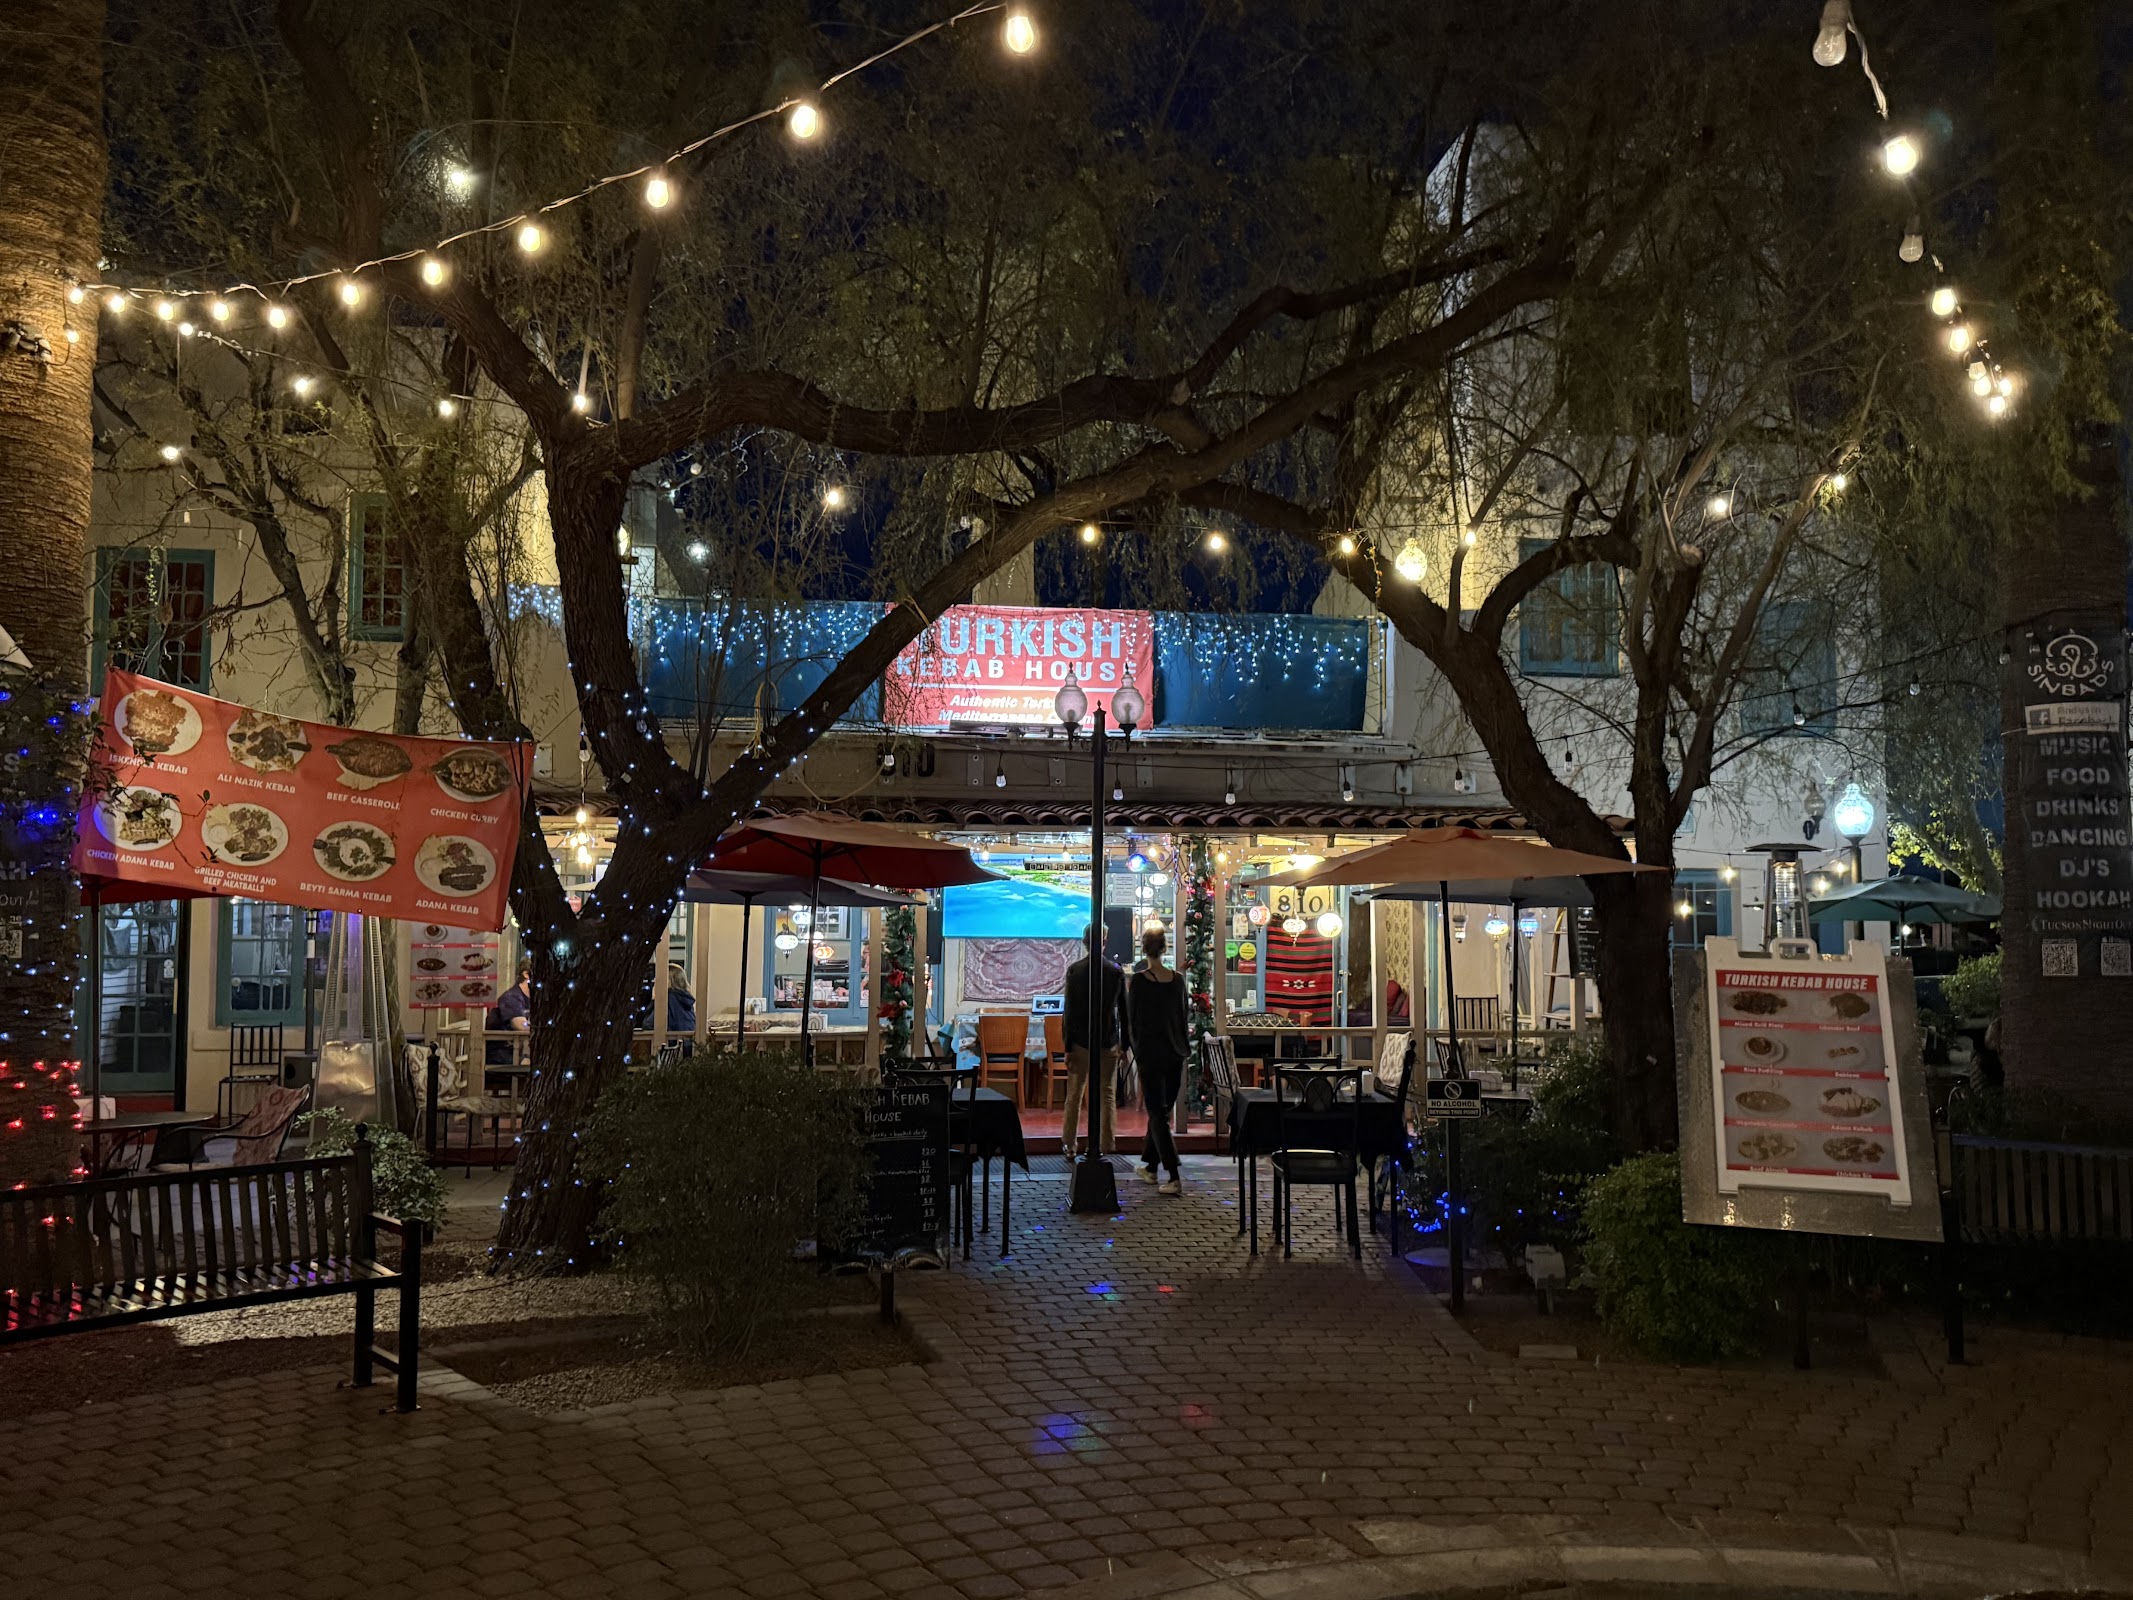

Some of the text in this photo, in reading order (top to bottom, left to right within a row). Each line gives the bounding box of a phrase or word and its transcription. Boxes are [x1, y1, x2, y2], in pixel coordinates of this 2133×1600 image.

[897, 656, 1005, 679] KEBAB
[949, 694, 1018, 709] Authentic
[2039, 736, 2112, 757] MUSIC
[156, 762, 188, 775] KEBAB
[2046, 767, 2111, 786] FOOD
[217, 773, 296, 794] ALI NAZIK KEBAB
[326, 791, 349, 803] BEEF
[2036, 797, 2120, 817] DRINKS
[430, 807, 498, 824] CHICKEN CURRY
[2030, 828, 2128, 849] DANCING
[87, 849, 175, 870] CHICKEN ADANA KEBAB
[2060, 860, 2111, 878] DJ'S
[194, 866, 277, 886] GRILLED CHICKEN AND
[203, 876, 265, 893] BEEF MEATBALLS
[299, 882, 392, 903] BEYTI SARMA KEBAB
[2036, 888, 2131, 910] HOOKAH
[415, 899, 479, 915] ADANA KEBAB
[1278, 894, 1323, 914] 810
[1725, 973, 1868, 990] TURKISH KEBAB HOUSE
